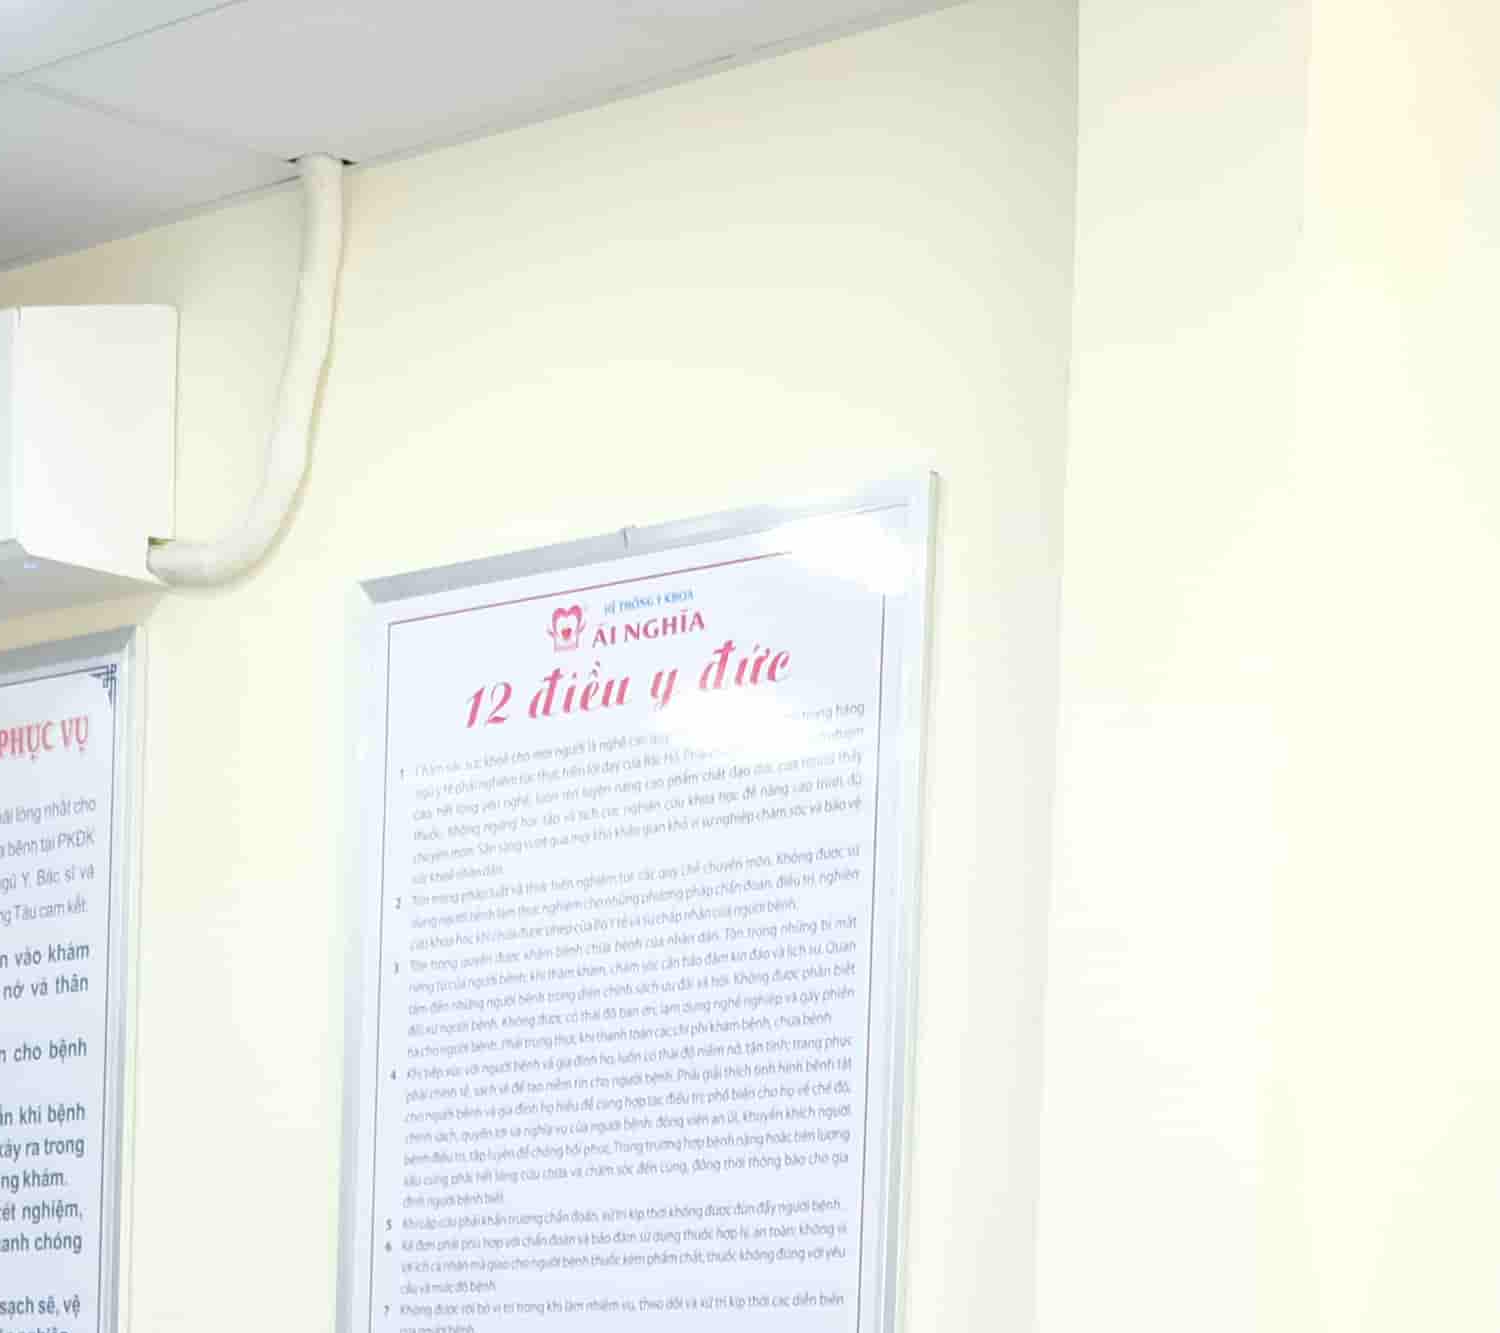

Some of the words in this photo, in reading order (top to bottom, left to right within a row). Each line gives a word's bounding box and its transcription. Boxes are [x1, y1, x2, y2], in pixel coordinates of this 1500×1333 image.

[623, 608, 706, 643] NGHĨA
[466, 681, 513, 728] 12
[528, 661, 631, 719] điều
[649, 667, 679, 711] y
[699, 639, 793, 690] đức
[58, 713, 90, 753] VỤ
